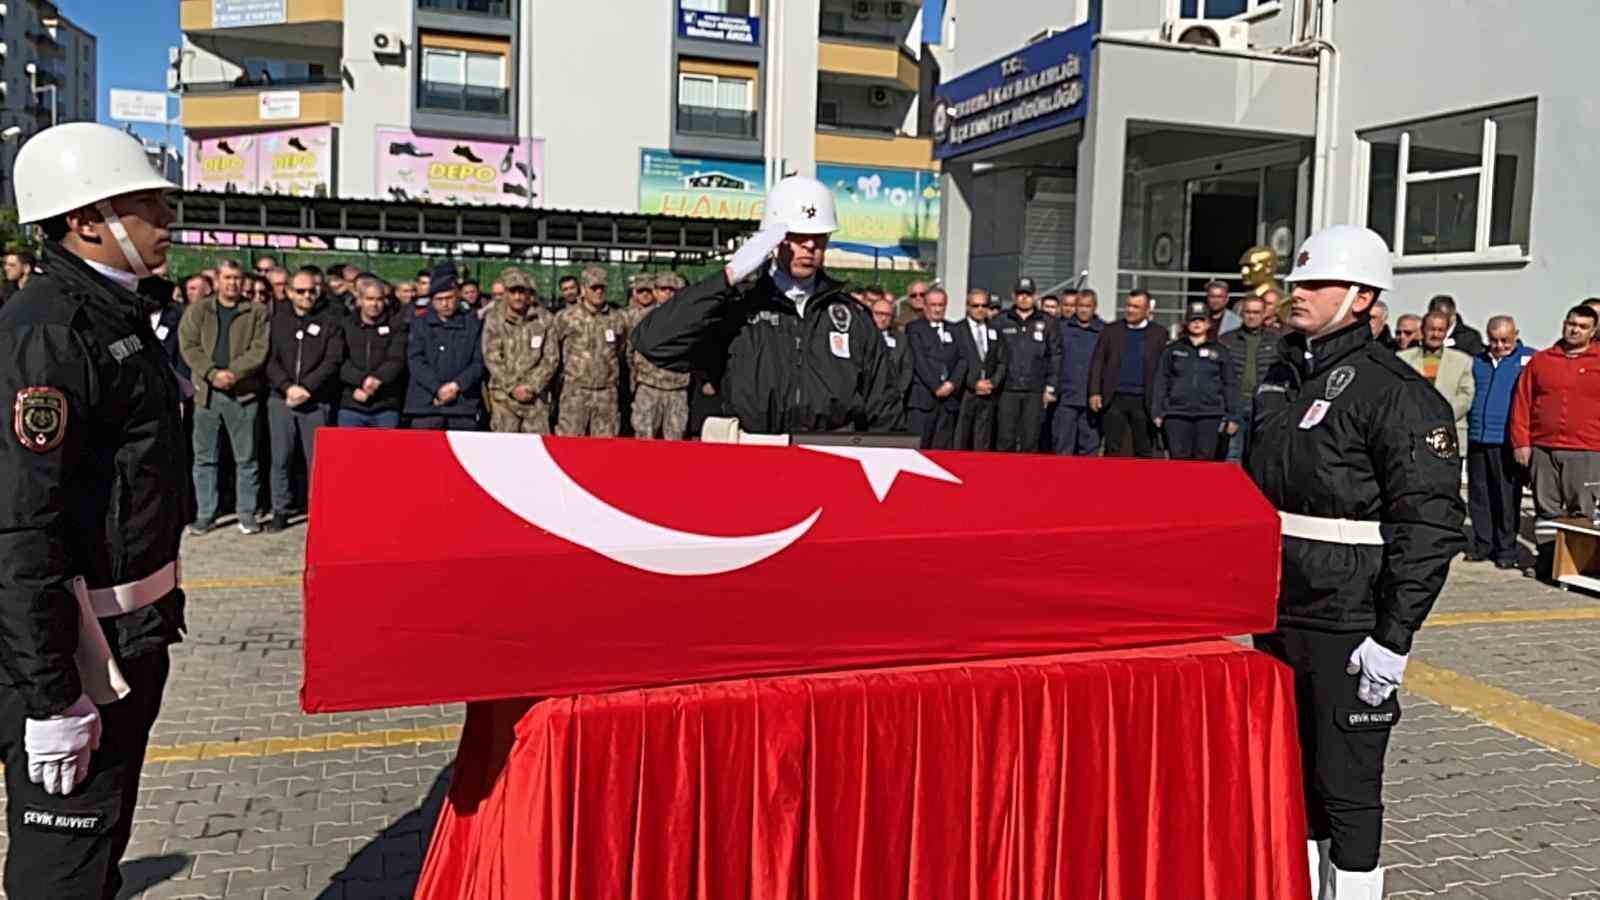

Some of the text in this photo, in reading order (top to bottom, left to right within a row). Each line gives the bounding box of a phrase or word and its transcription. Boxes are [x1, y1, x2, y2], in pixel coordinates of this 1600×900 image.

[203, 155, 245, 172] DEPO
[271, 152, 318, 170] DEPO
[430, 161, 497, 184] DEPO
[24, 811, 98, 828] ÇEVİK KUVVET
